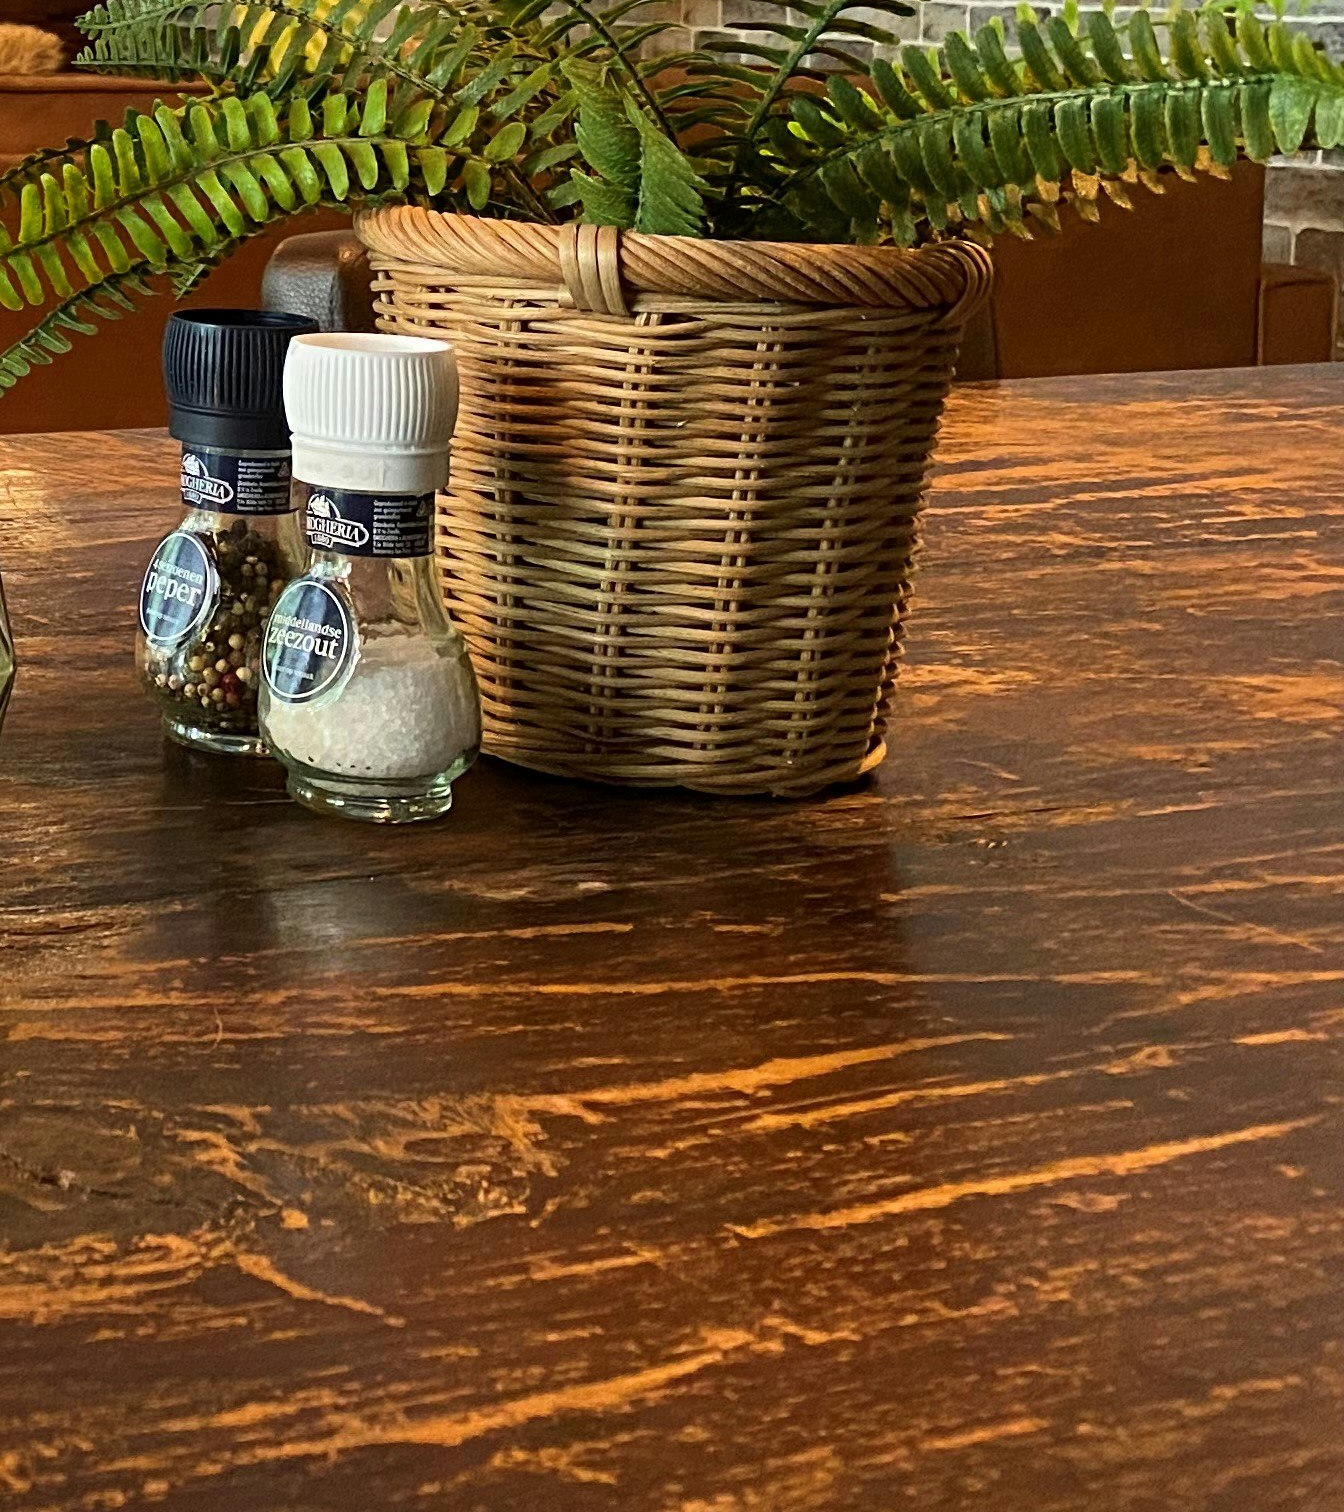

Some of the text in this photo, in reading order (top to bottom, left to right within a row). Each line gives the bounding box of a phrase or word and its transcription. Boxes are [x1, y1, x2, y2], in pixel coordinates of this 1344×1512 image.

[146, 571, 202, 607] peper
[272, 614, 342, 639] middellandse
[268, 627, 339, 660] zeezout
